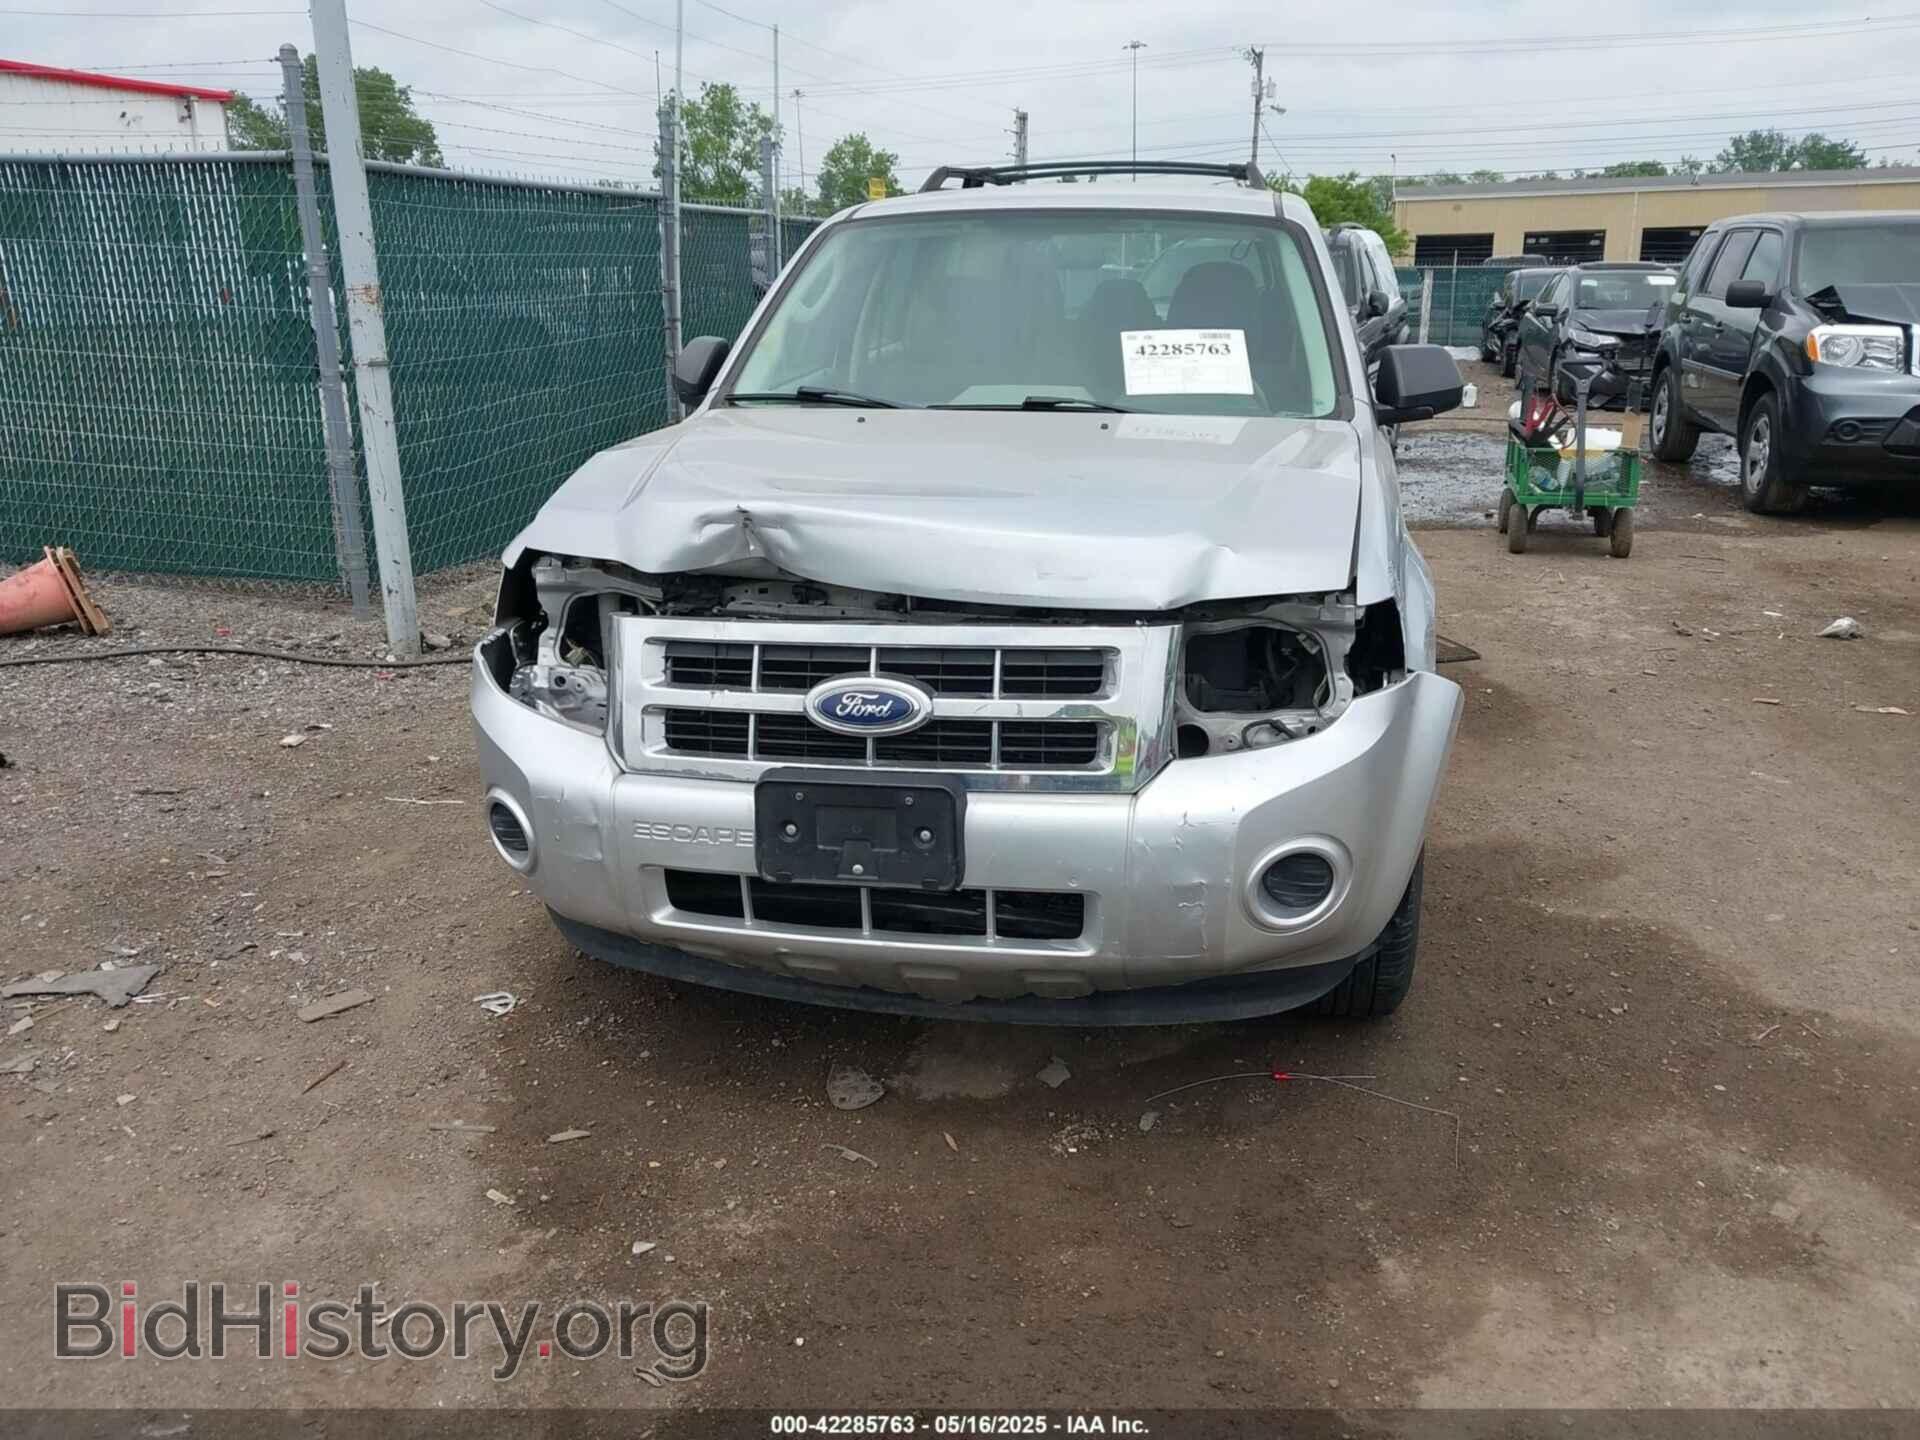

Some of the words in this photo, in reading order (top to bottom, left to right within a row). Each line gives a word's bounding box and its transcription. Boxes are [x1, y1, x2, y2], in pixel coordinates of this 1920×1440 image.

[1135, 343, 1232, 356] 42285763
[835, 692, 894, 718] Ford
[632, 820, 754, 848] ESCAPE
